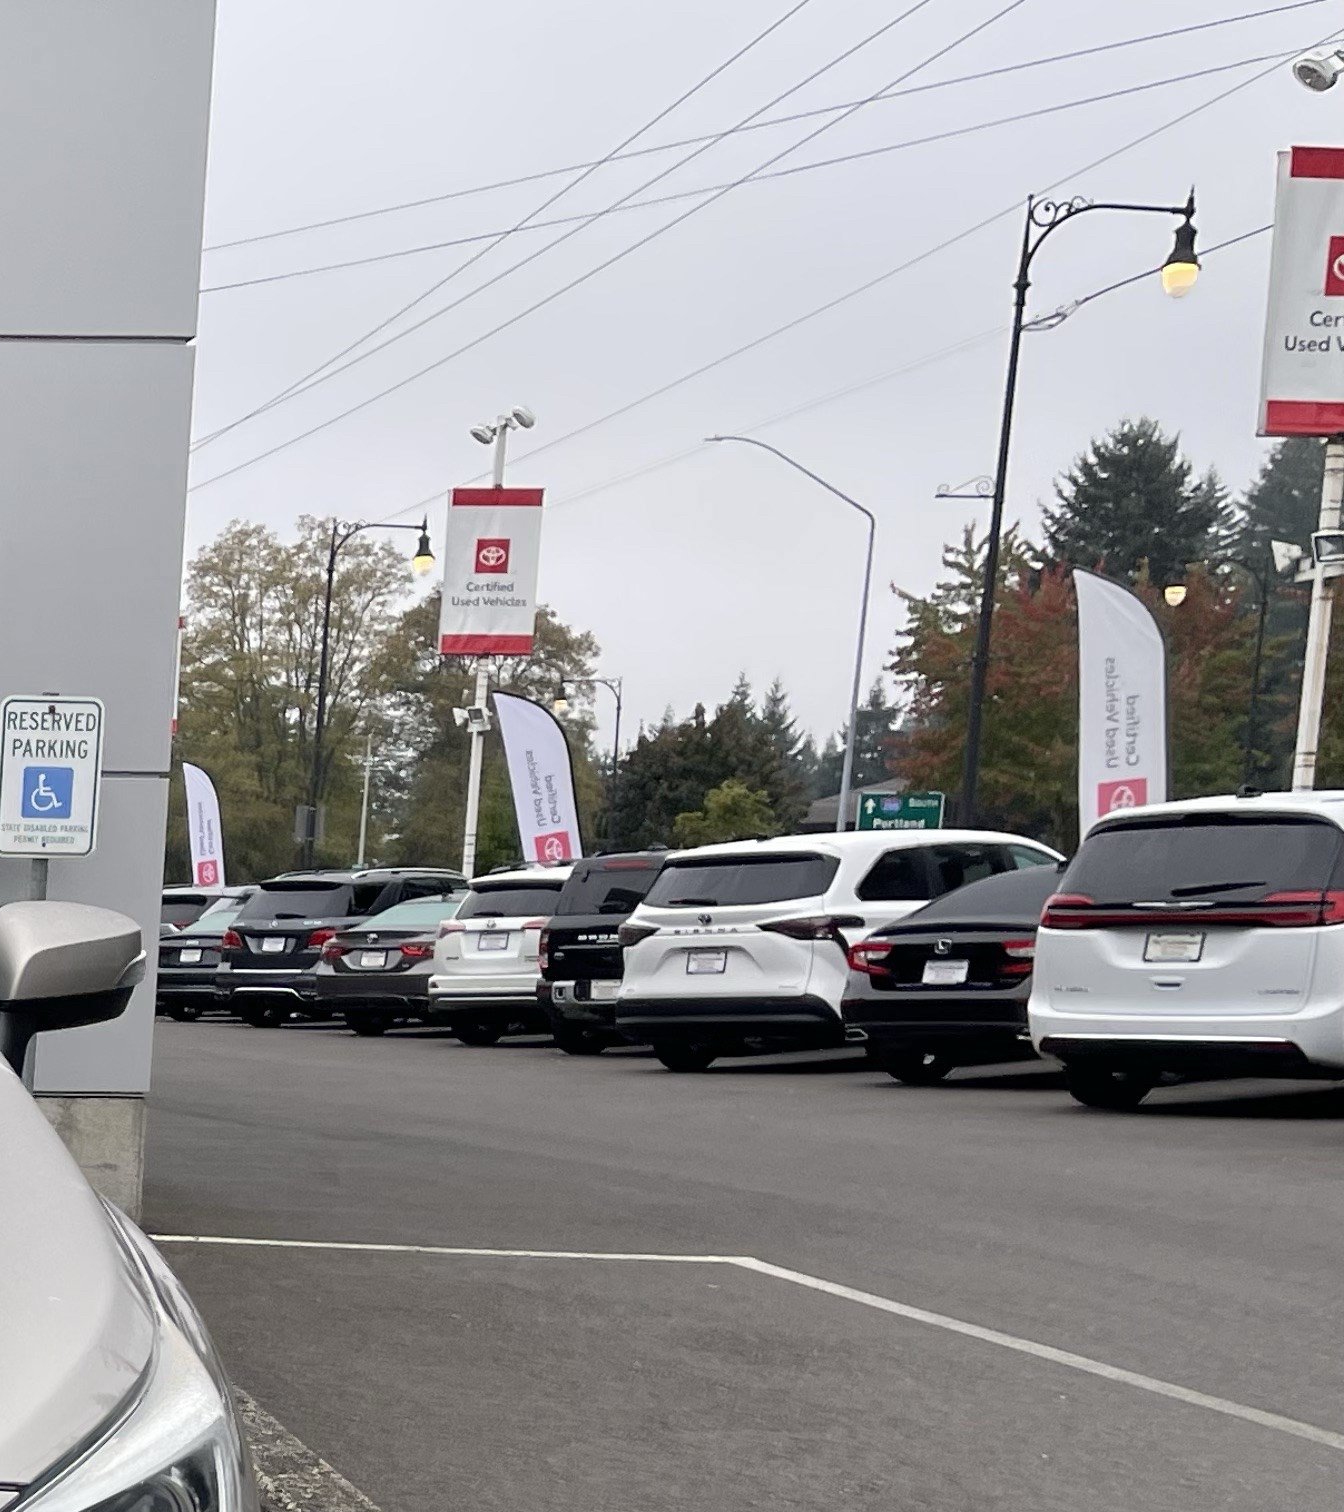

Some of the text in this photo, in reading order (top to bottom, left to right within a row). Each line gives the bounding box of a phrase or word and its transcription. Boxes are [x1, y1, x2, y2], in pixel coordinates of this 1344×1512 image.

[1310, 310, 1344, 327] Cer
[1285, 335, 1331, 352] Used
[466, 581, 514, 593] Certified
[451, 596, 527, 607] Used Vehicles
[6, 711, 97, 732] RESERVED
[12, 738, 89, 759] PARKING
